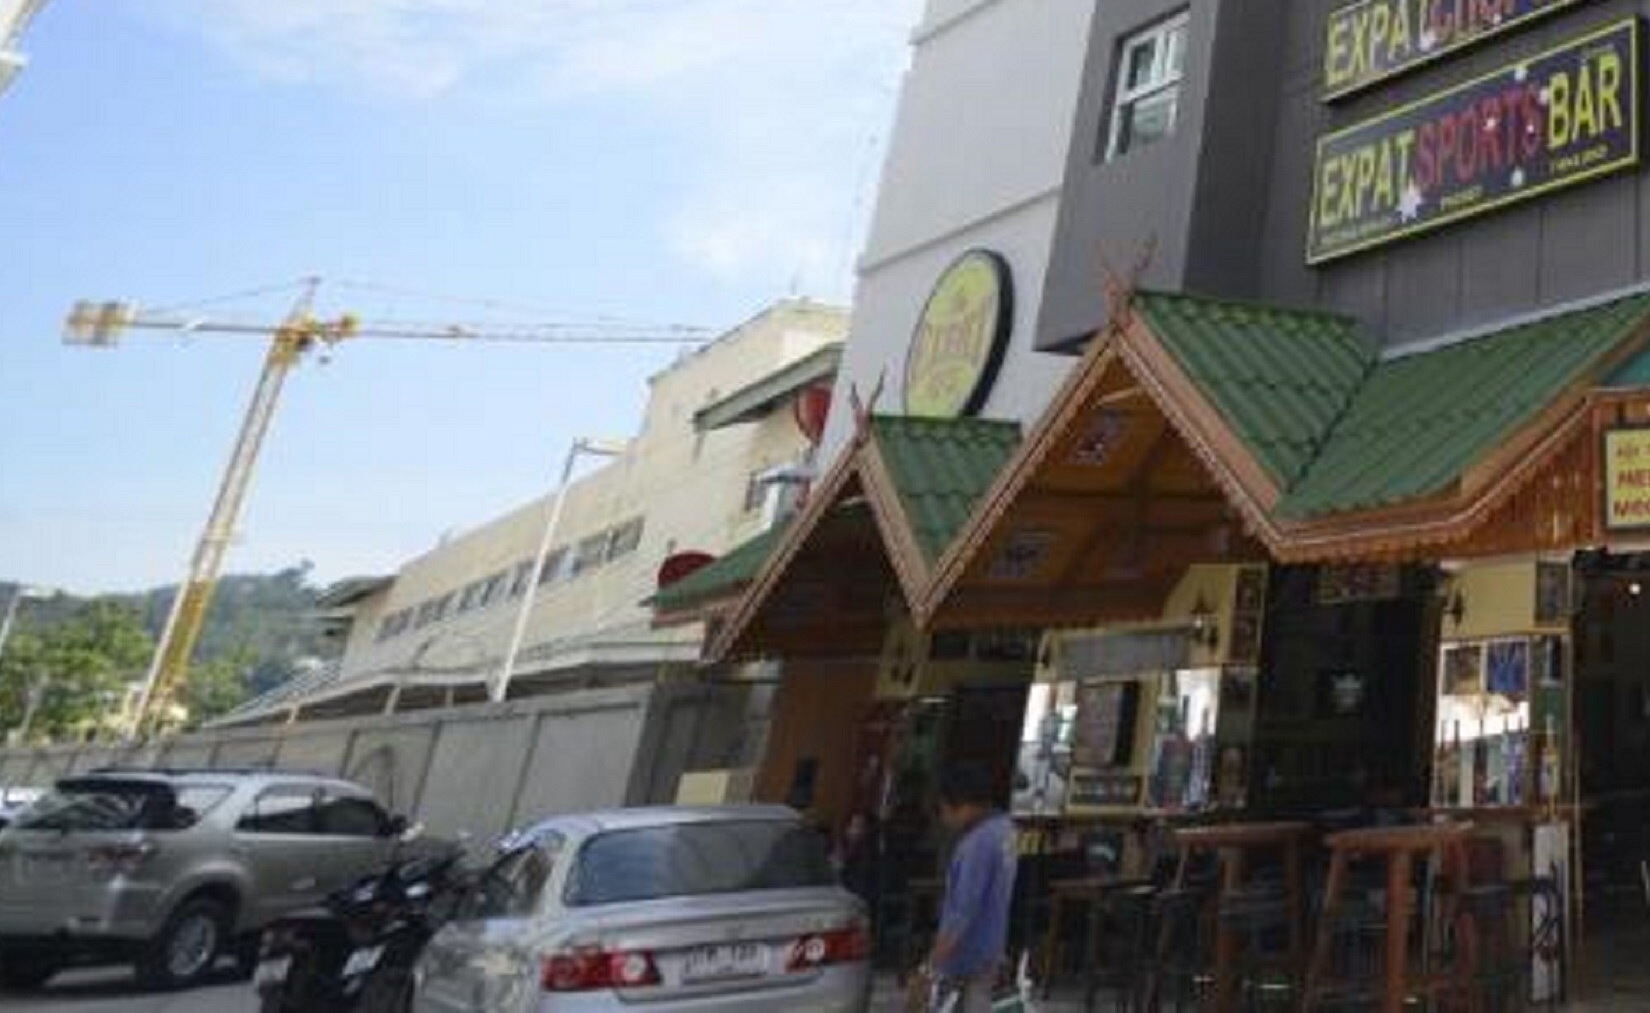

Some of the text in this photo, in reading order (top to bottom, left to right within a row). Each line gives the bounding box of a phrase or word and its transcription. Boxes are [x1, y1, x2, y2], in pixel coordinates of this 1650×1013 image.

[1320, 51, 1622, 225] EXPAT SPORTS BAR
